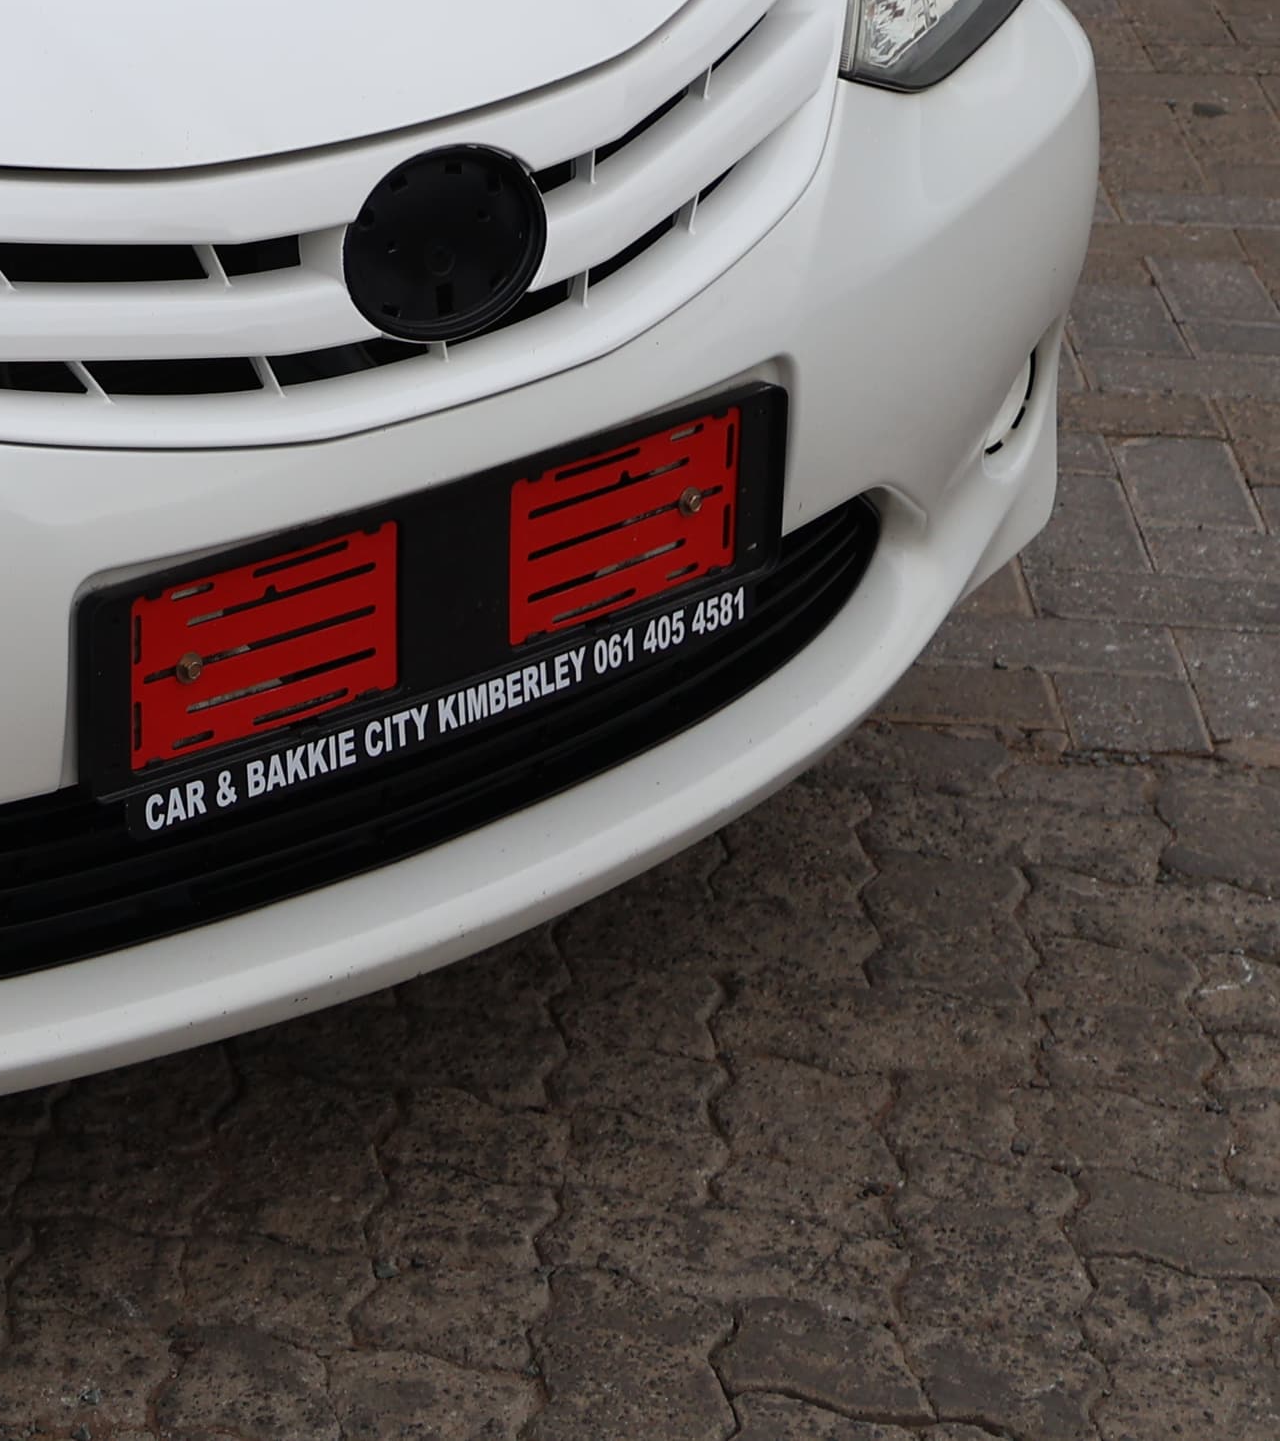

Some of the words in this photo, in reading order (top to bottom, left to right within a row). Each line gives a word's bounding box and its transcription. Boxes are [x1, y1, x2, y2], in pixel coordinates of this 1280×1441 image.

[145, 779, 207, 830] CAR
[215, 769, 238, 807] &
[246, 728, 357, 798] BAKKIE
[364, 704, 429, 757] CITY
[437, 645, 586, 734] KIMBERLEY
[593, 628, 634, 674] 061
[642, 609, 686, 654] 405
[691, 586, 745, 635] 4581
